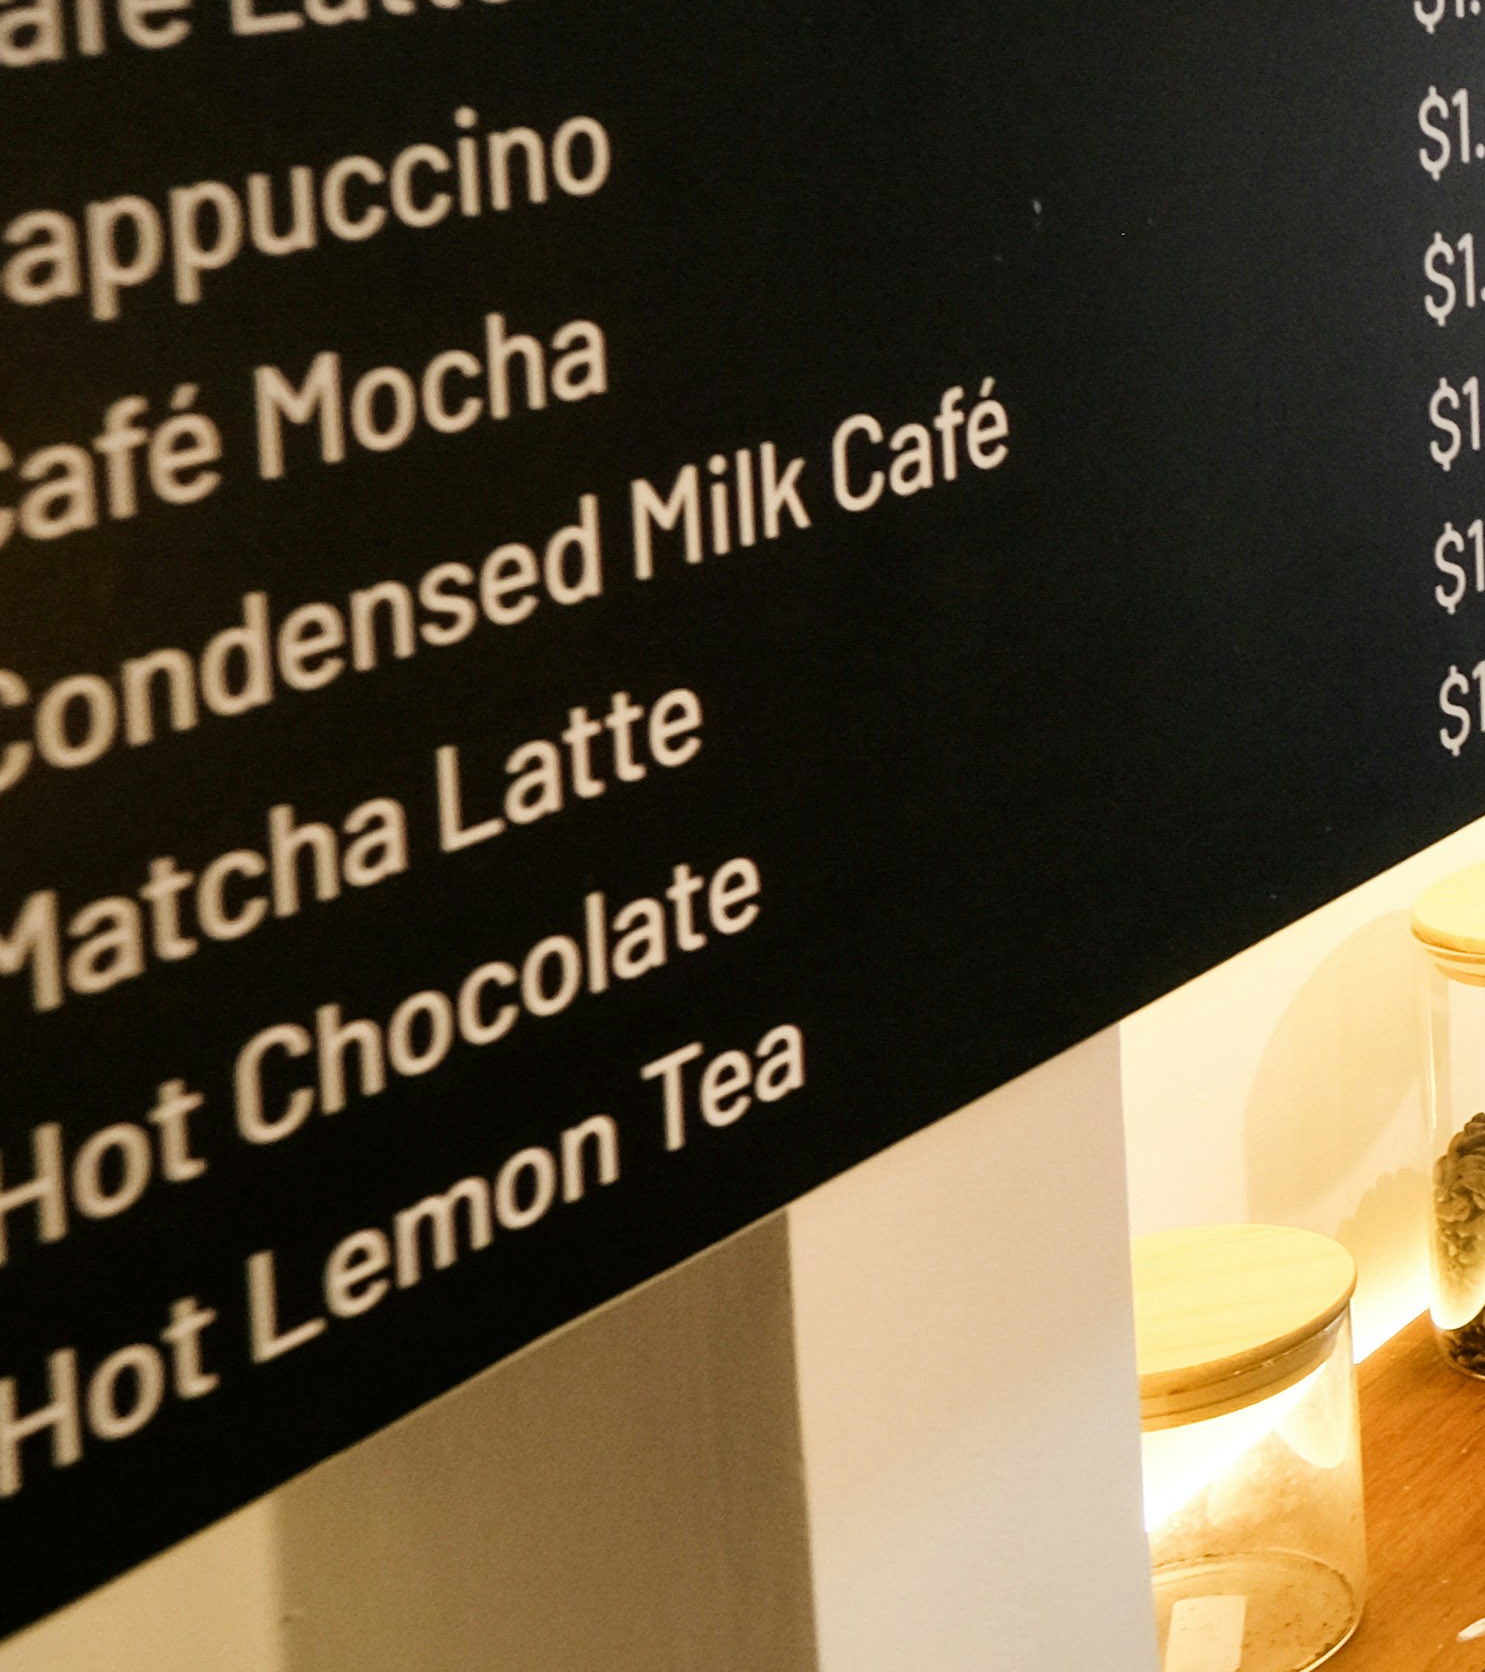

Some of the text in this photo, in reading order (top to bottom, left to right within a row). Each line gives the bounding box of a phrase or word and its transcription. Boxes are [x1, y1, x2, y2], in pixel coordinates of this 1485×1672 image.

[4, 106, 611, 320] appuccino
[0, 313, 607, 546] afé Mocha
[631, 441, 811, 580] Milk
[832, 376, 1009, 512] Café
[436, 688, 702, 852] Latte
[0, 857, 760, 1265] Hot Chocolate
[0, 1024, 804, 1499] Hot Lemon Tea
